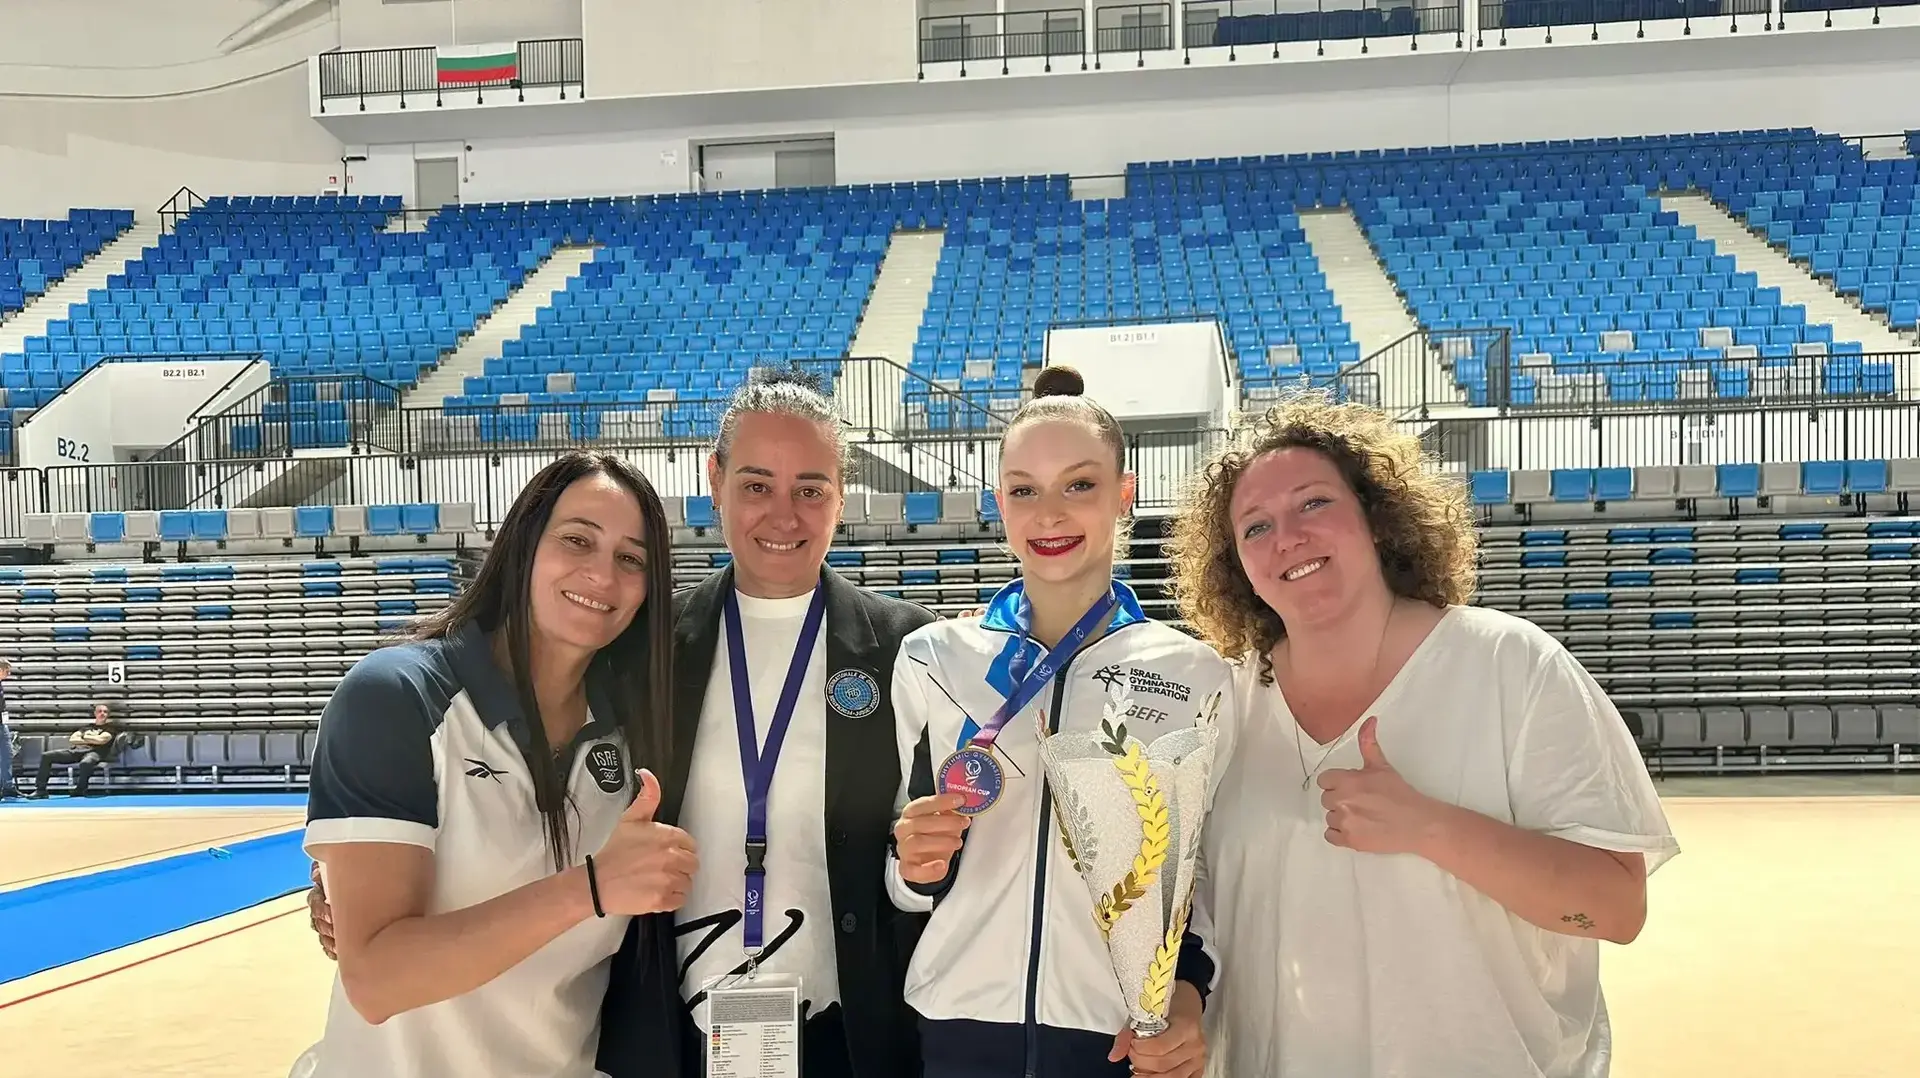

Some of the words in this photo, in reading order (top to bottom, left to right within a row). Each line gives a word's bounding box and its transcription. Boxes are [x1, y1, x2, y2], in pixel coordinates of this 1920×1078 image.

[163, 369, 181, 377] B2.2
[187, 369, 205, 377] B2.1
[57, 437, 90, 463] B2.2
[111, 667, 121, 683] 5
[1129, 667, 1163, 681] ISRAEL
[1129, 676, 1191, 694] GYMNASTICS
[940, 752, 969, 779] RHYTHMIC
[973, 752, 1001, 789] GYMNASTICS
[947, 783, 977, 793] EUROPEAN
